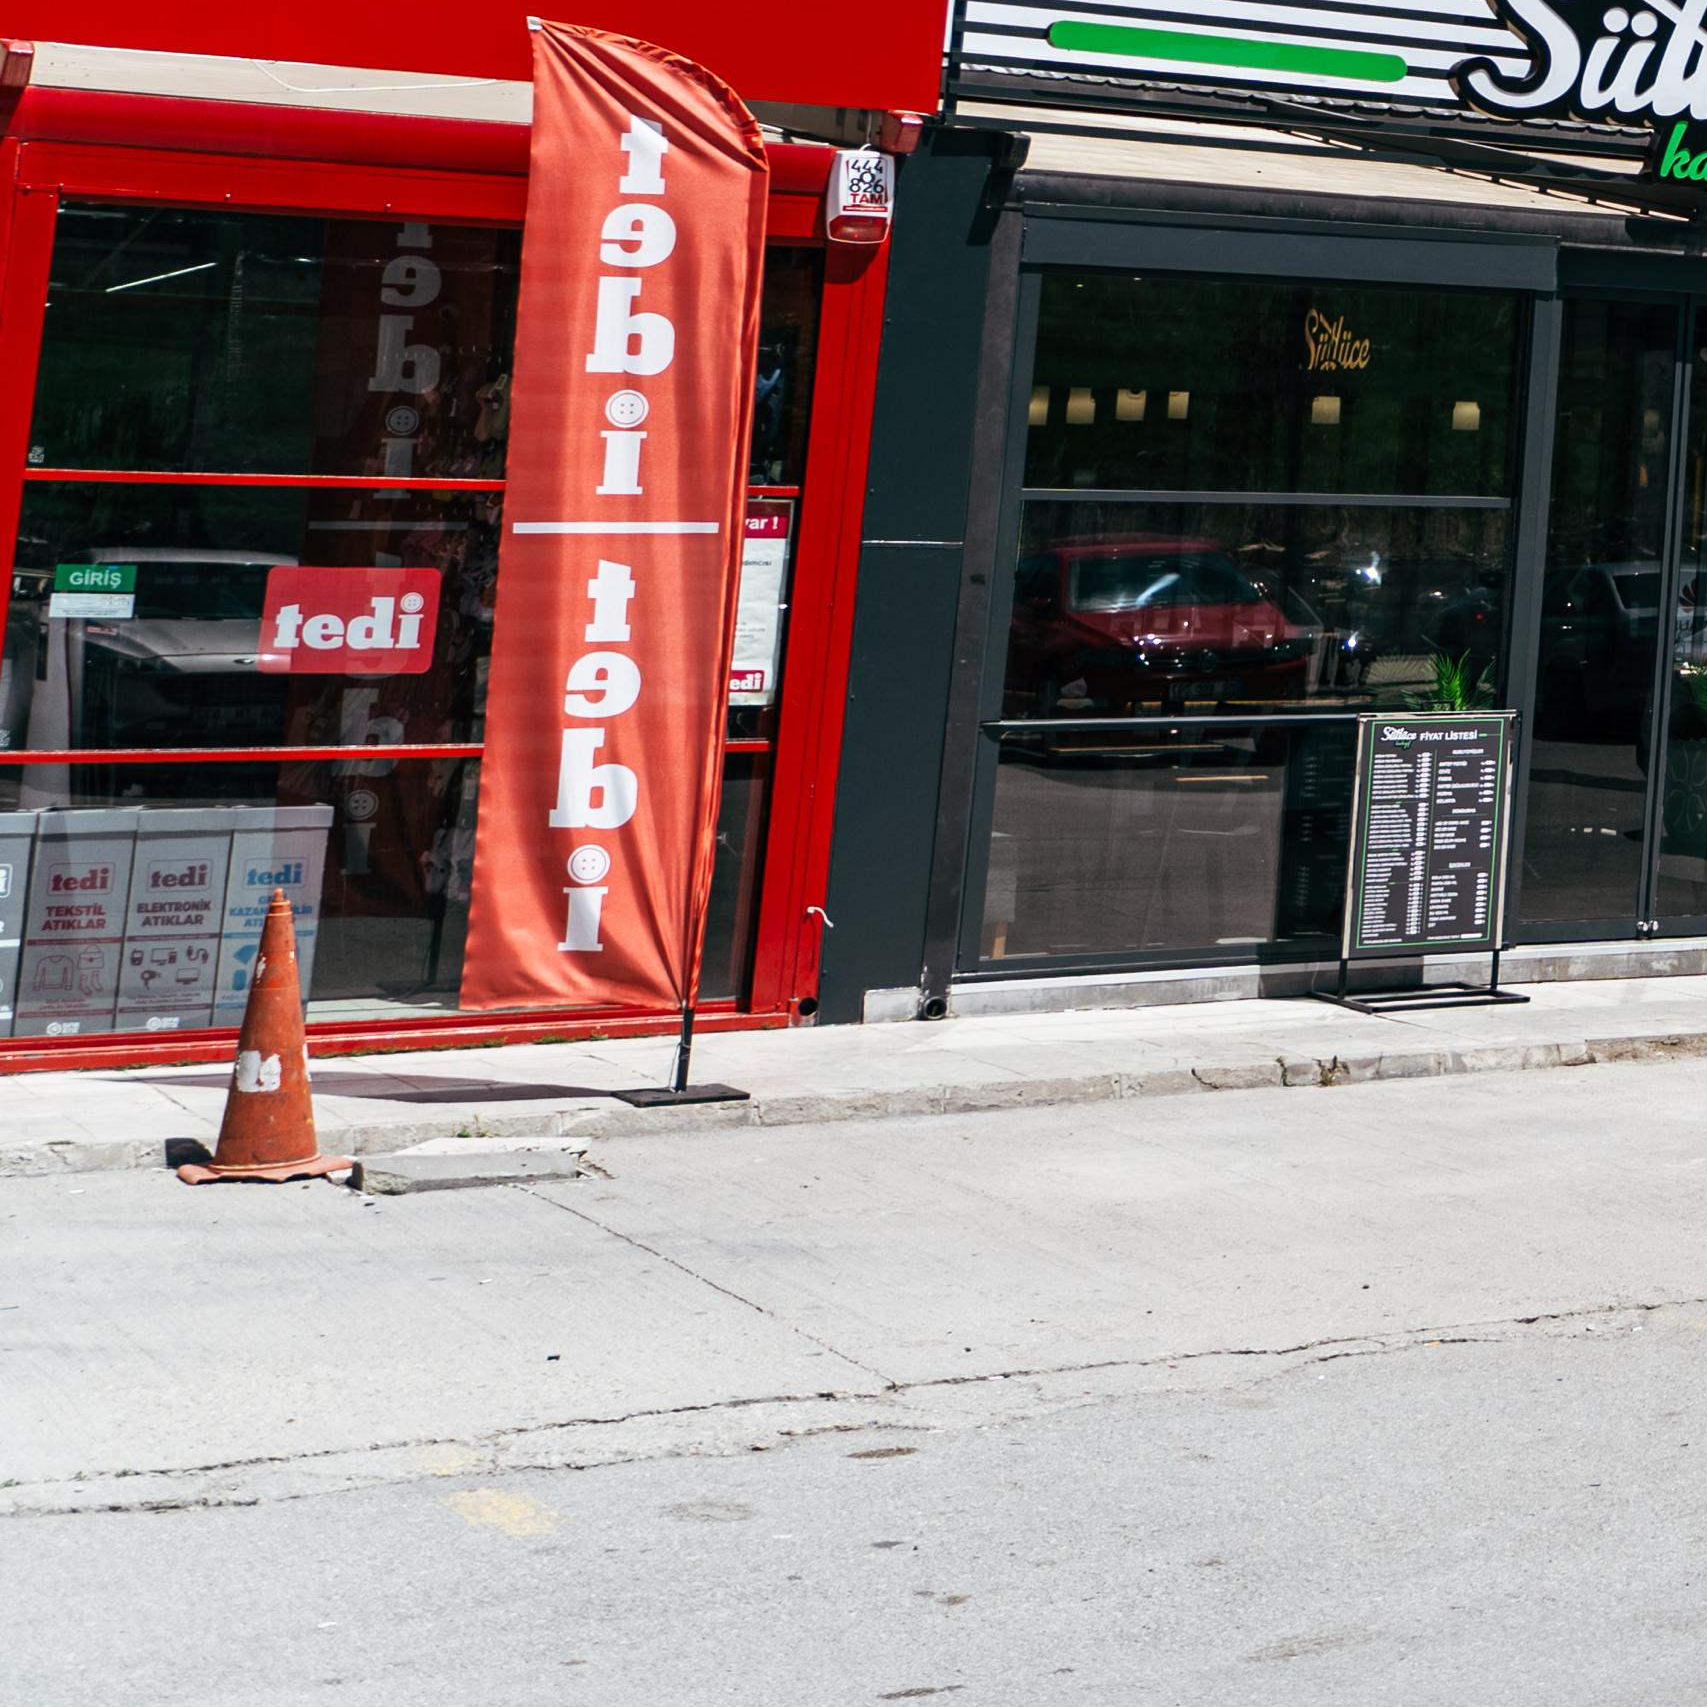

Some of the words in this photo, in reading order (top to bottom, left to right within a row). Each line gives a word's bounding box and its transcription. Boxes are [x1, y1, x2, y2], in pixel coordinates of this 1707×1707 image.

[849, 178, 884, 194] 826
[850, 193, 883, 205] TAM
[69, 569, 122, 589] GİRİŞ
[273, 591, 425, 650] tedi
[1420, 731, 1443, 742] FİYAT
[1445, 729, 1478, 741] LİSTESİ
[51, 868, 110, 892] tedi
[150, 864, 208, 888] tedi
[247, 863, 305, 886] tedi
[46, 902, 106, 917] TEKSTİL
[42, 918, 107, 931] ATIKLAR
[142, 915, 205, 927] ATIKLAR
